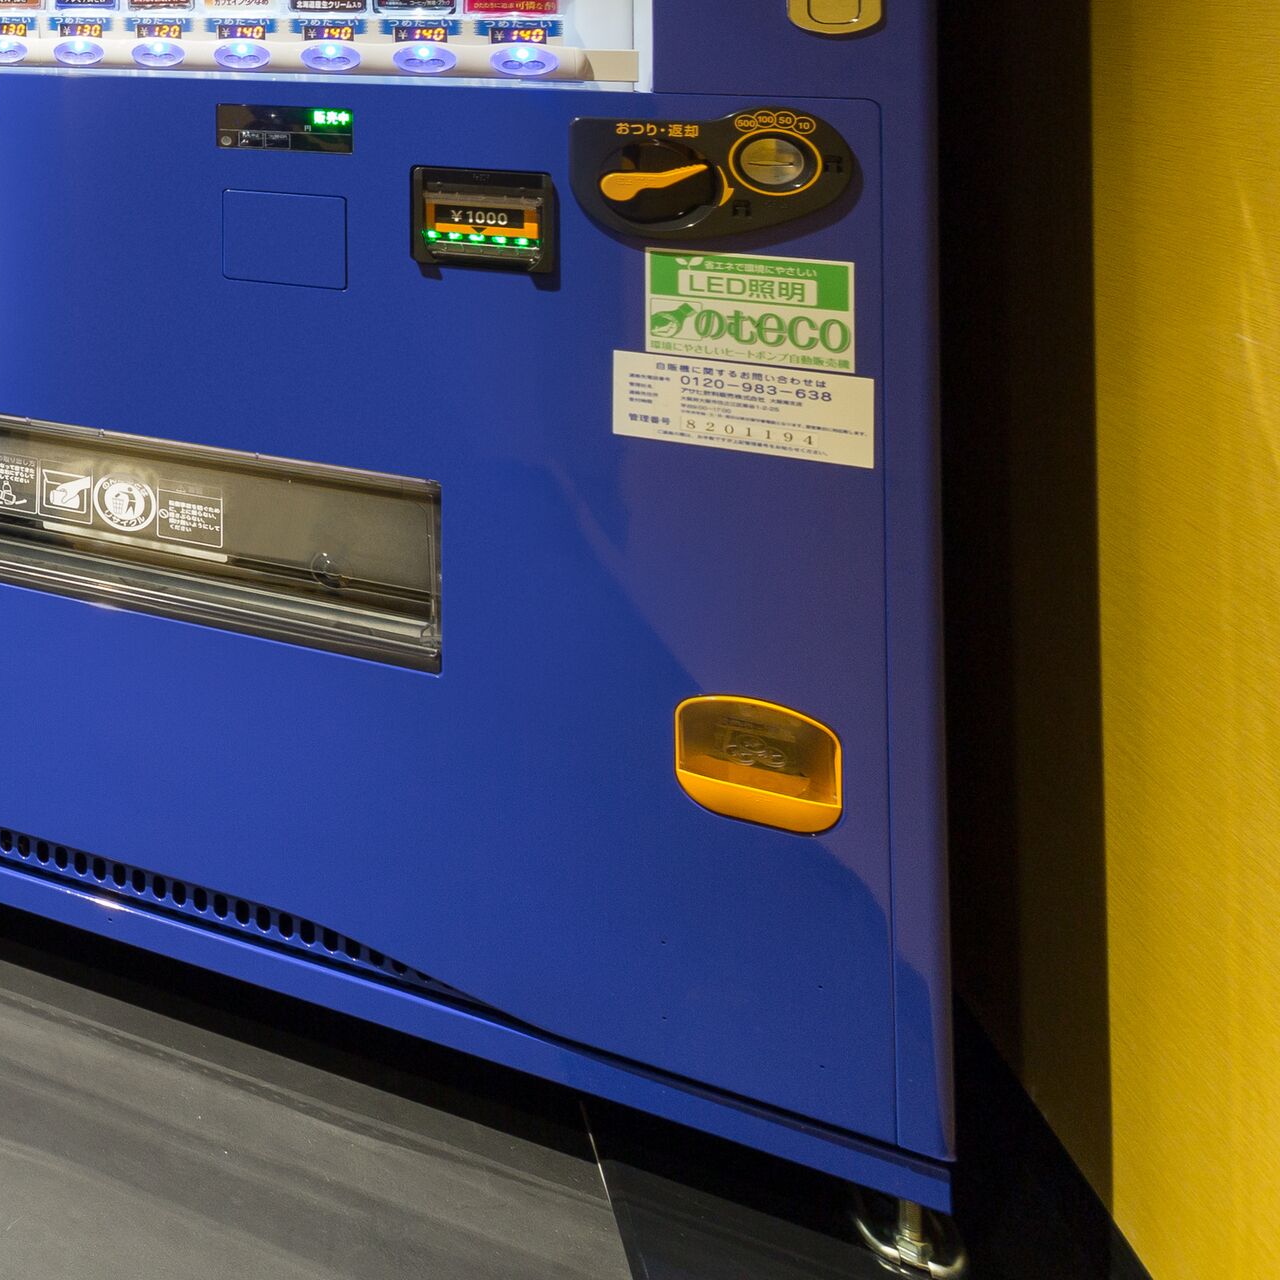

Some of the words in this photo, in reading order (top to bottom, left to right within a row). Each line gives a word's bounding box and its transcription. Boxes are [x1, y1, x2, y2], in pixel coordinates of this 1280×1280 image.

[312, 111, 351, 126] 販売中
[736, 118, 756, 129] 500
[758, 114, 775, 125] 100
[777, 115, 792, 126] 50
[797, 121, 810, 131] 10
[615, 122, 699, 138] おつり・返却
[450, 209, 509, 227] ¥1000
[704, 259, 818, 278] 省エネで環境にやさしい
[689, 274, 806, 303] LED照明
[694, 309, 851, 354] のむeco
[105, 510, 145, 527] リサイクル
